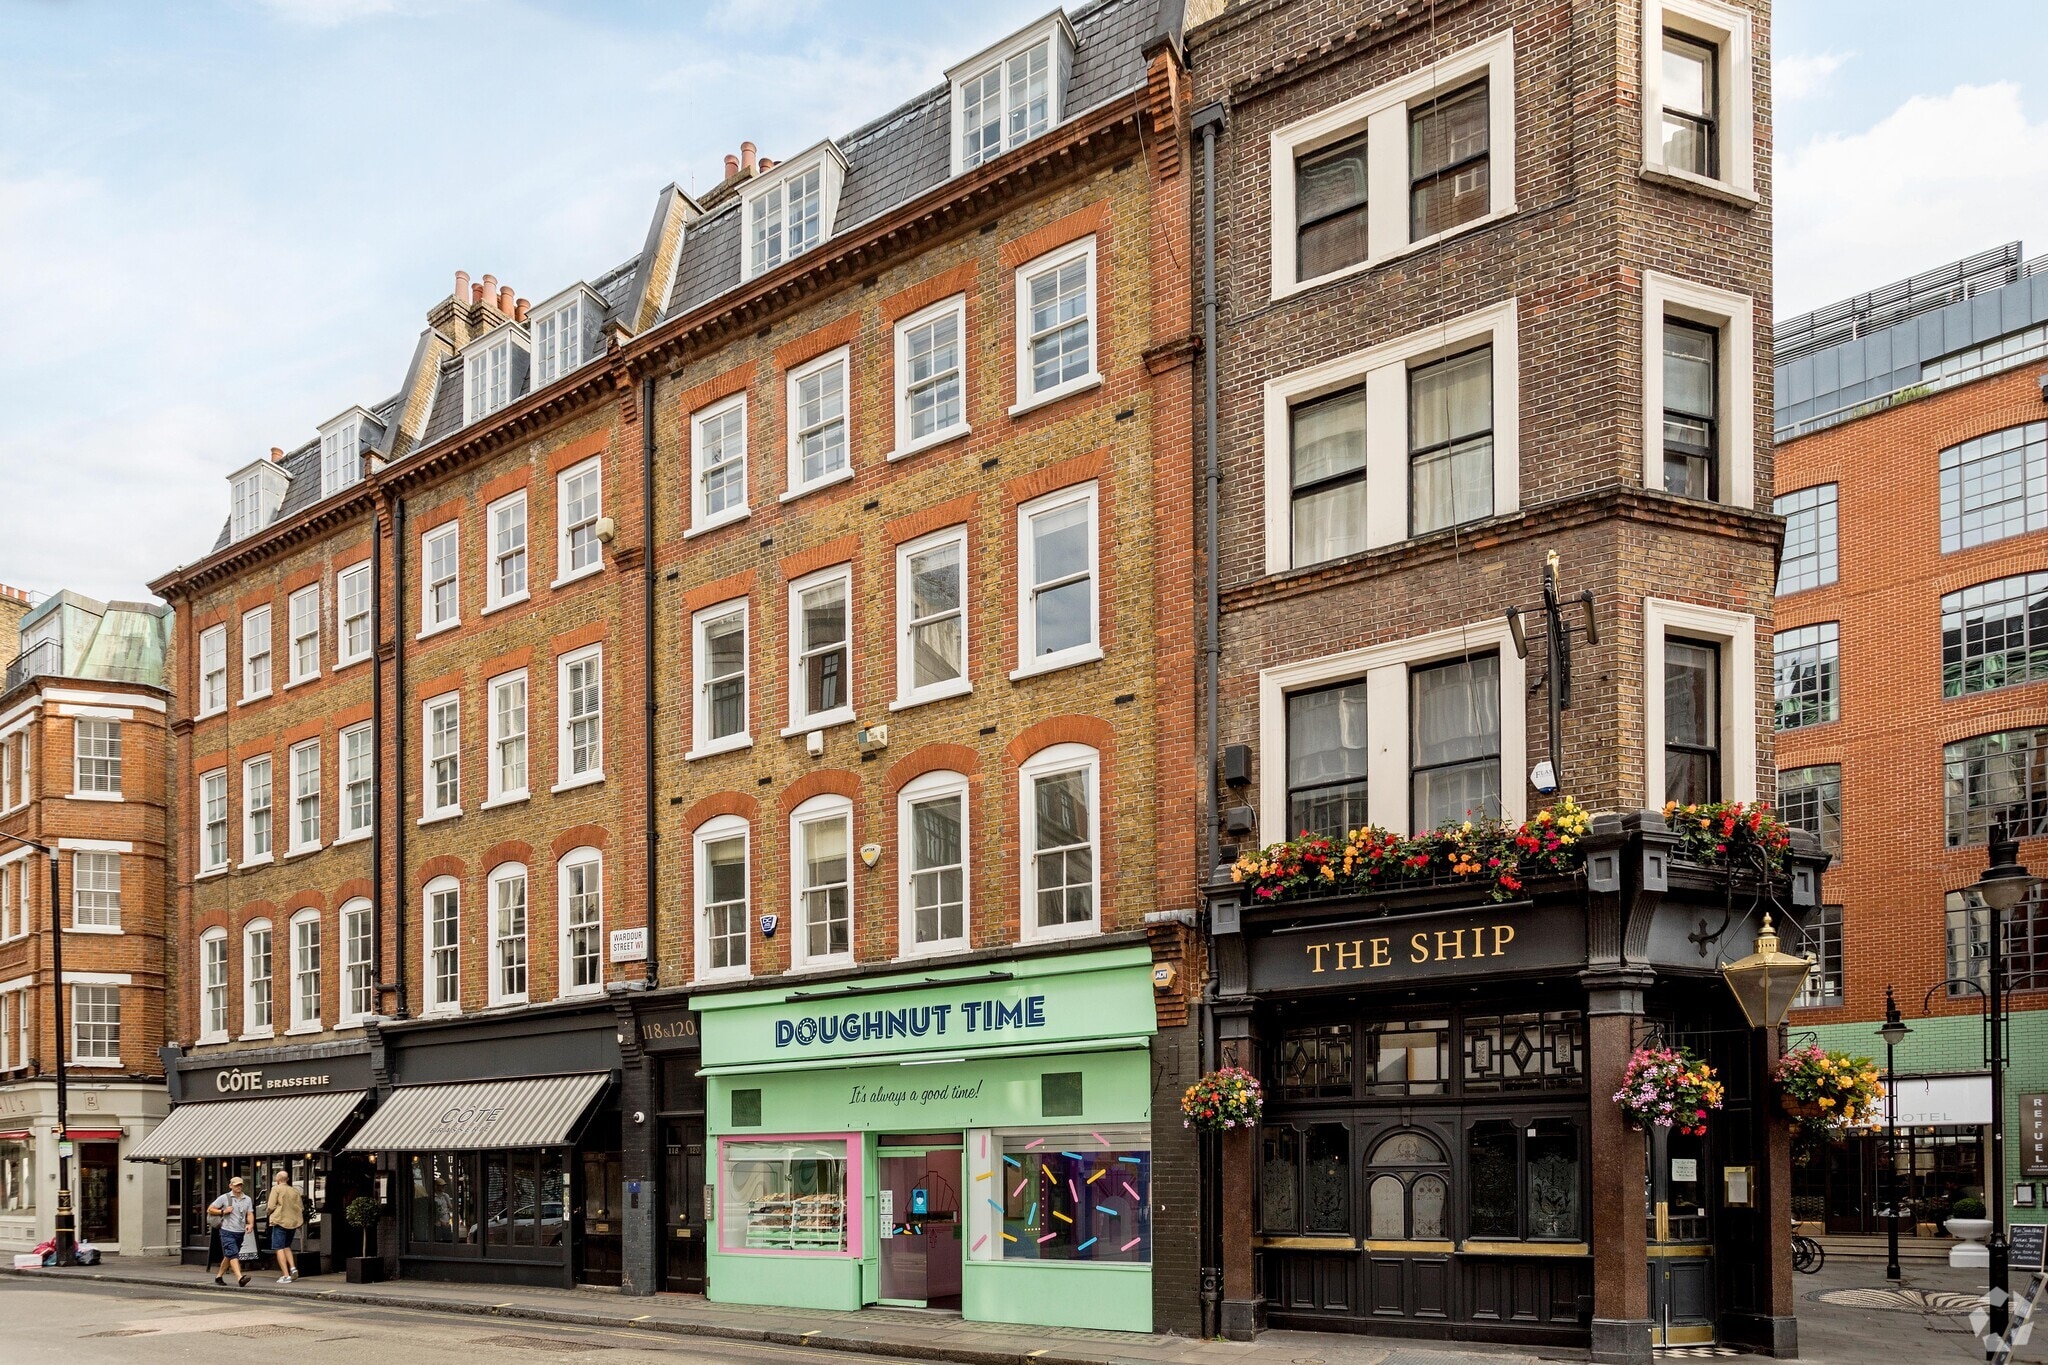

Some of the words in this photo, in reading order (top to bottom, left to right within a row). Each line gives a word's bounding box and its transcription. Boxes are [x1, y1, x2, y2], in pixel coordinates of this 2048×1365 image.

[613, 931, 643, 942] WARDOUR
[613, 942, 634, 952] STREET
[635, 941, 644, 950] W1
[1306, 937, 1392, 973] THE
[1410, 925, 1515, 964] SHIP
[775, 1004, 951, 1048] DOUGHNUT
[961, 995, 1046, 1032] TIME
[216, 1068, 263, 1093] CÔTE
[266, 1075, 330, 1089] BRASSERIE
[849, 1085, 867, 1105] It's
[869, 1086, 907, 1107] always
[909, 1090, 919, 1101] a
[920, 1085, 949, 1106] good
[951, 1079, 984, 1100] time!
[1901, 1112, 1953, 1123] OTEL
[2033, 1098, 2044, 1163] REFUEL
